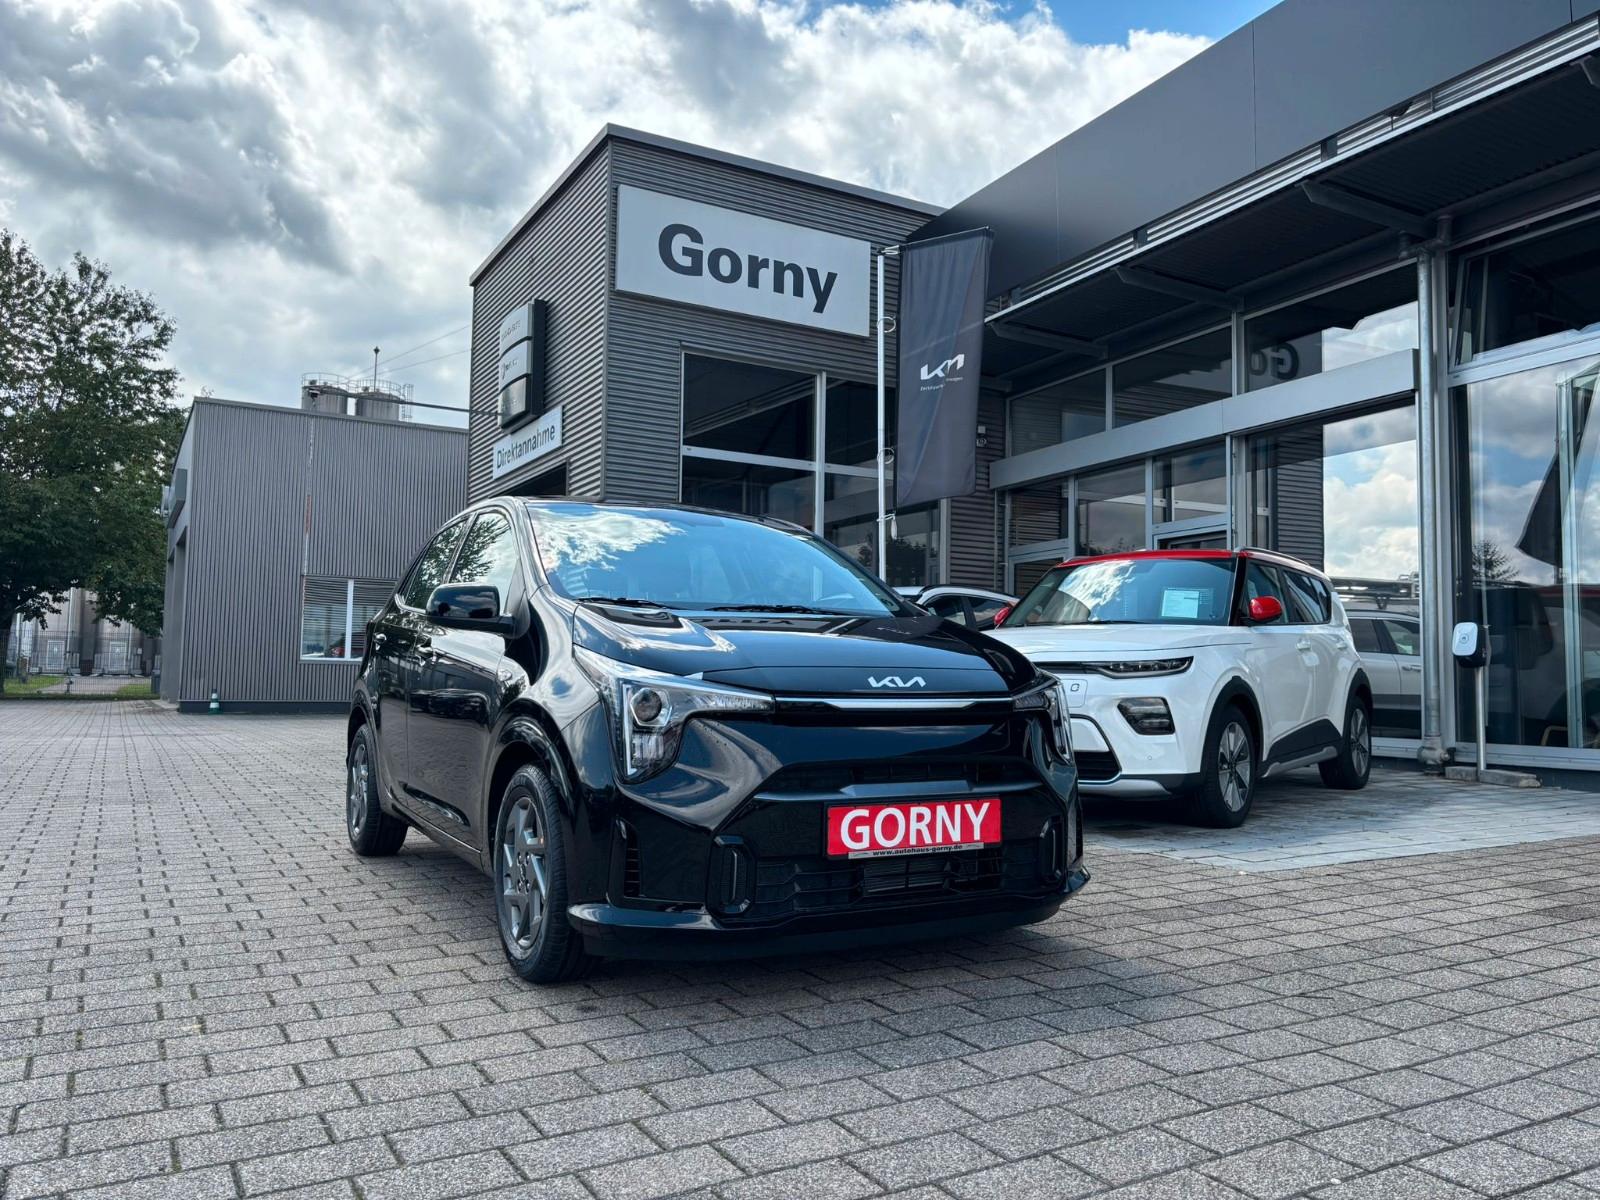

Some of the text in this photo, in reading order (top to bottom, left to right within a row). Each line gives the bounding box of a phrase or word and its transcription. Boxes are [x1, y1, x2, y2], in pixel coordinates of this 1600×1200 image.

[658, 223, 838, 313] Gorny
[496, 424, 556, 469] Direktannahme
[840, 802, 990, 850] GORNY
[872, 844, 963, 856] www.autohaus-gorny.de
